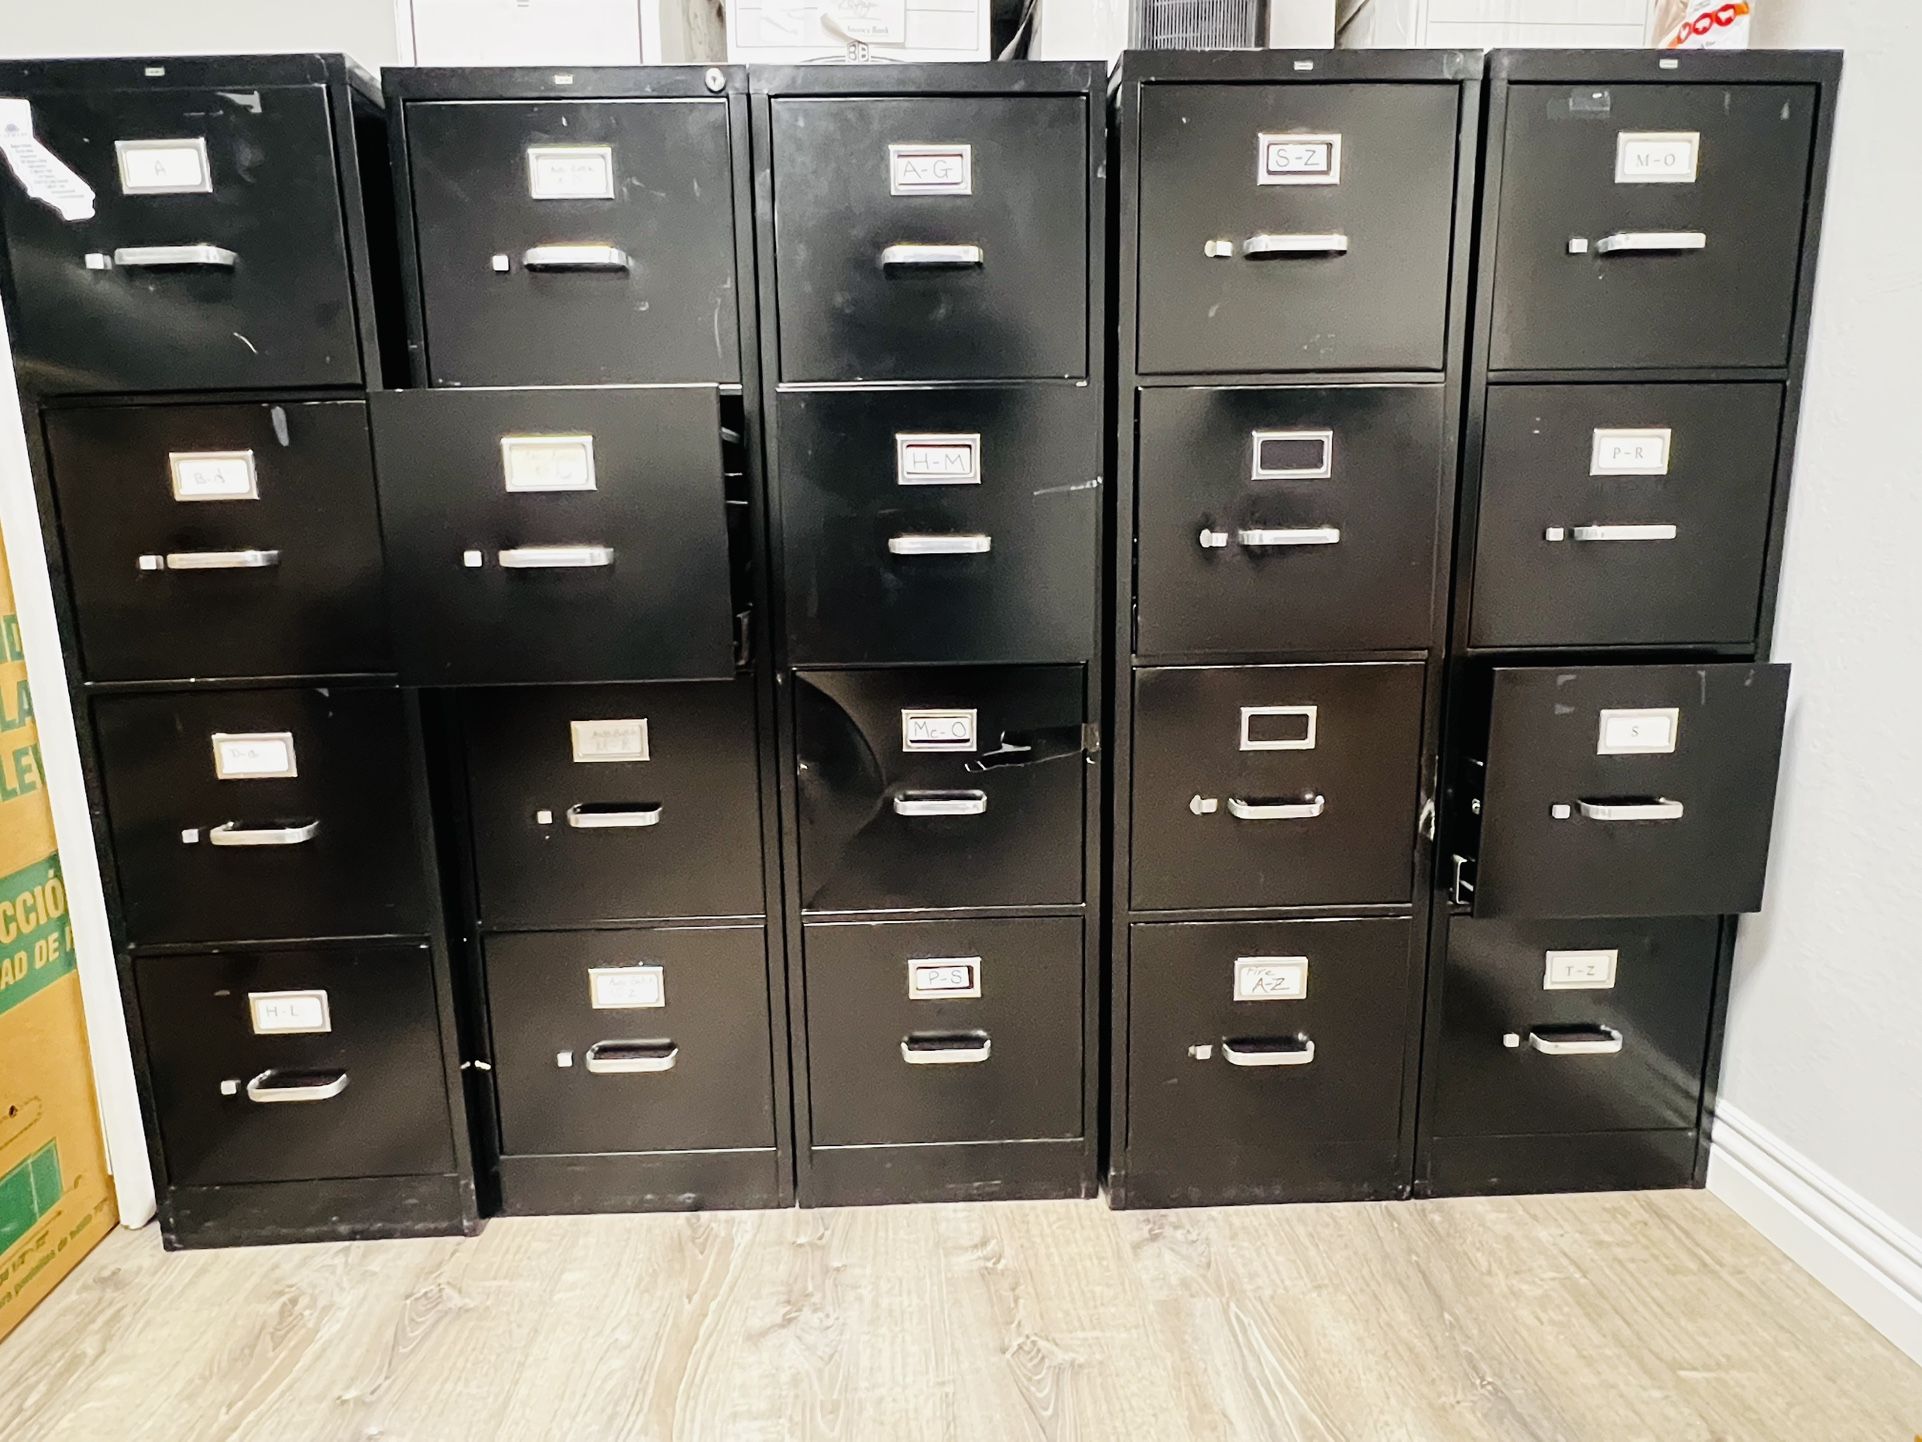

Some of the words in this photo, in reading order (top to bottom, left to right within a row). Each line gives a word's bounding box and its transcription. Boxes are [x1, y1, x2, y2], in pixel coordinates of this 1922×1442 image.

[1275, 148, 1320, 168] S-Z
[1636, 153, 1676, 167] M-O
[903, 159, 953, 179] A-G
[1612, 446, 1644, 460] P-R
[912, 452, 966, 472] H-M
[914, 721, 967, 738] Mc-O
[1631, 725, 1640, 737] S
[34, 932, 59, 970] DE
[928, 970, 962, 985] P-S
[1565, 965, 1595, 976] T-Z
[1251, 977, 1290, 993] A-Z
[265, 1005, 299, 1017] H-L
